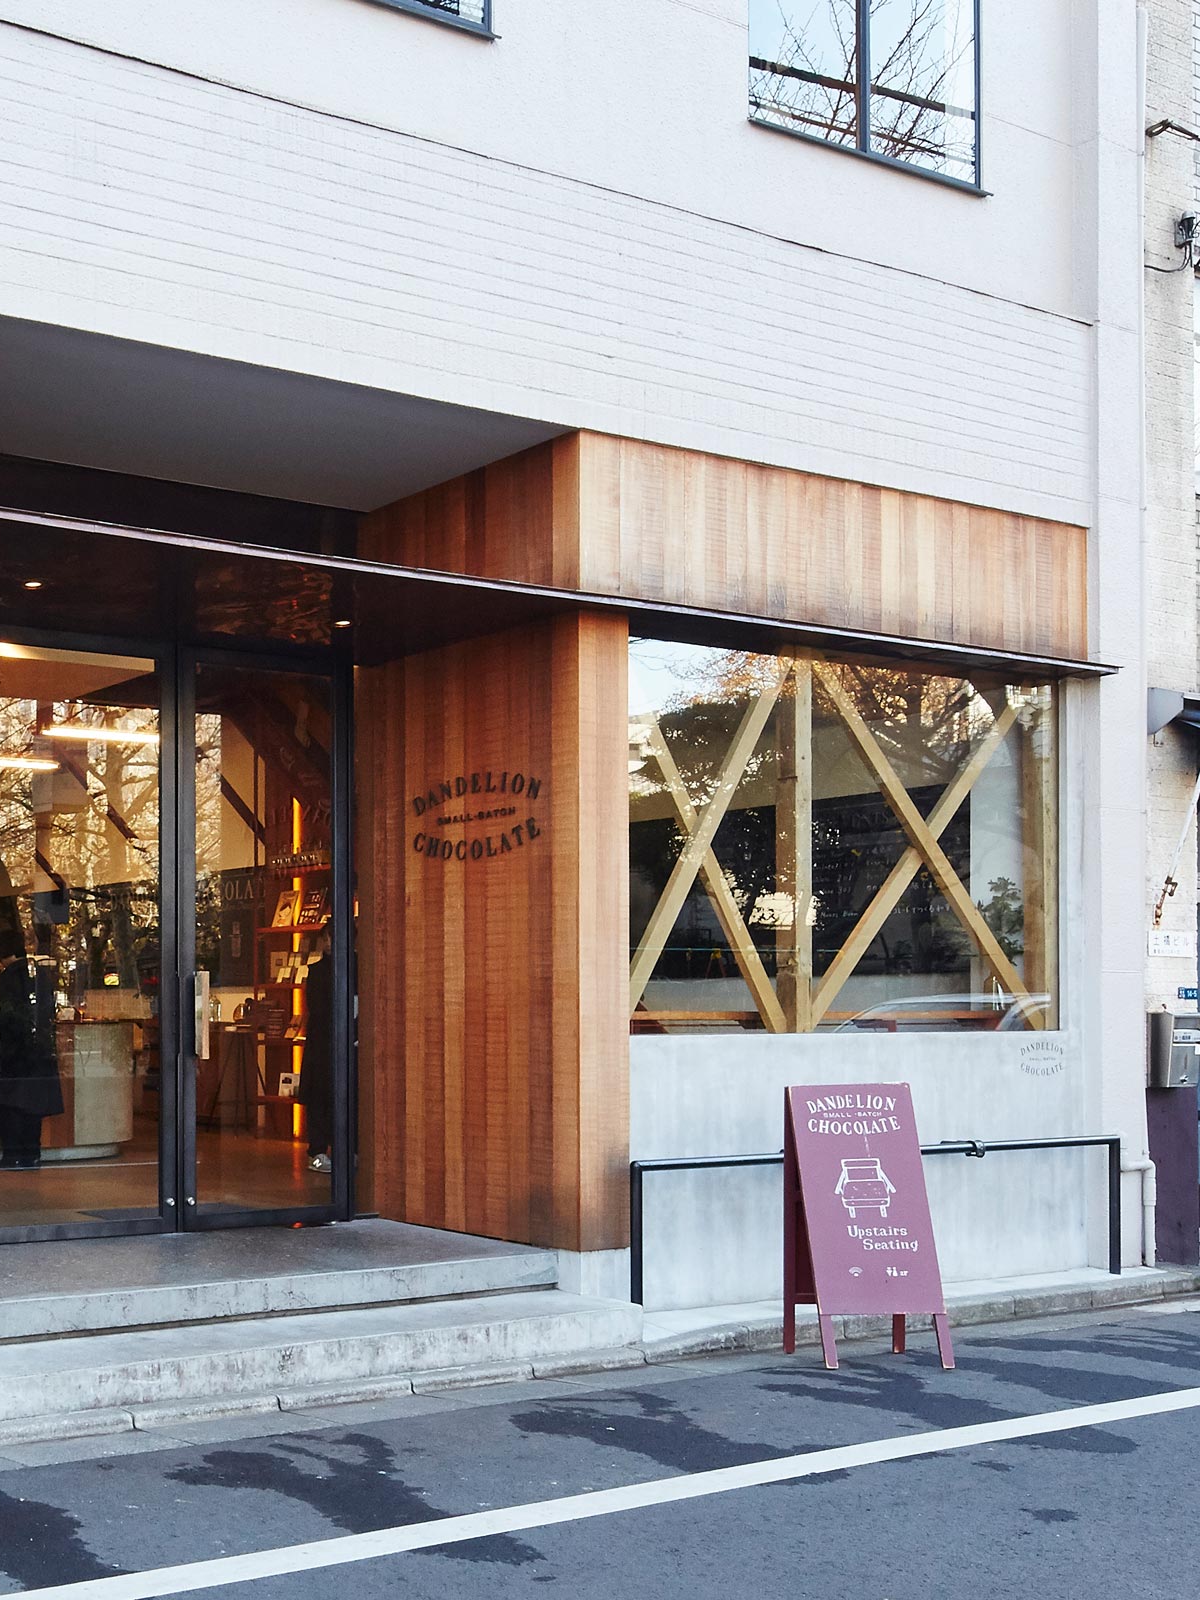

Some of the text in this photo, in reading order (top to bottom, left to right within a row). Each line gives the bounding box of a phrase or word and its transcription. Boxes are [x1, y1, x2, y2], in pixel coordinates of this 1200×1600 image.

[413, 771, 542, 816] DANDELION
[413, 817, 541, 861] CHOCOLATE
[1020, 1041, 1064, 1056] DANDELION
[1020, 1062, 1064, 1076] CHOCOLATE
[806, 1094, 897, 1114] DANDELION
[807, 1115, 901, 1136] CHOCOLATE
[847, 1225, 908, 1239] Upstairs
[863, 1238, 919, 1252] Seating
